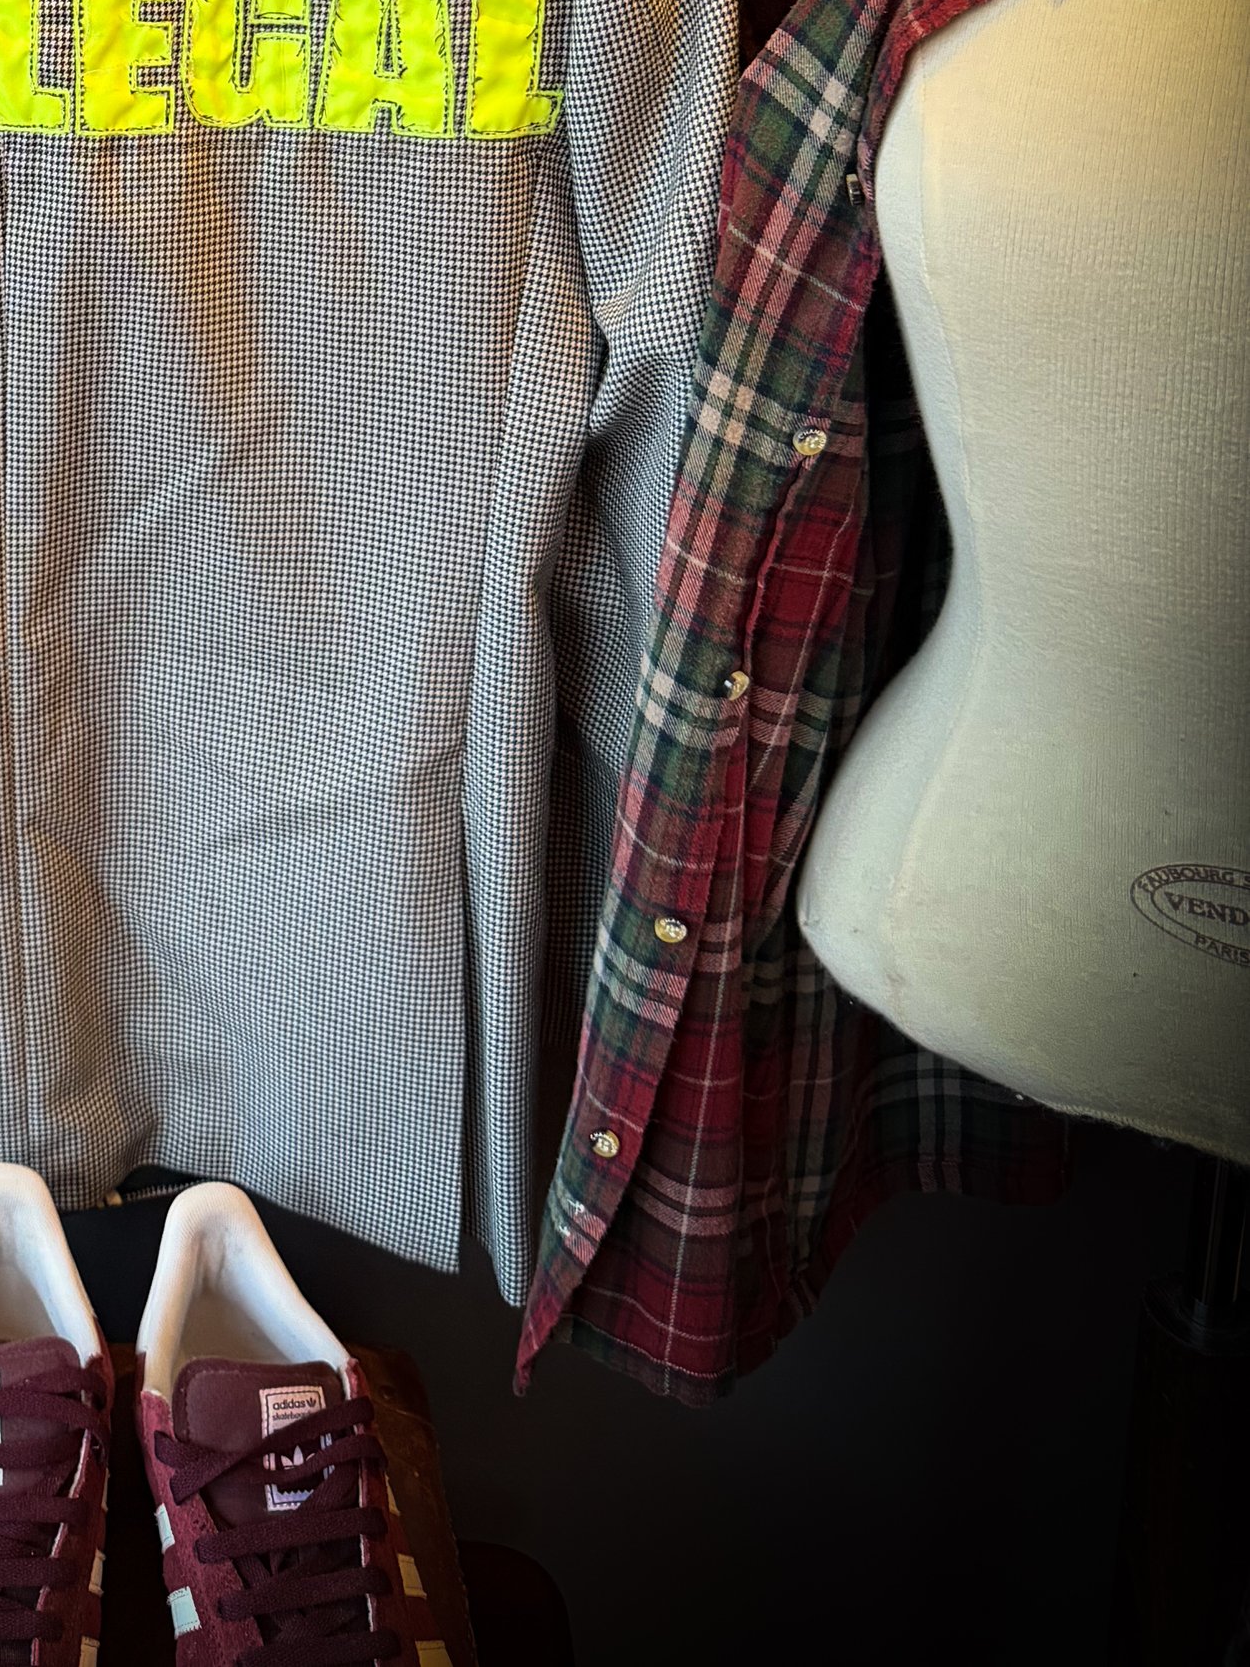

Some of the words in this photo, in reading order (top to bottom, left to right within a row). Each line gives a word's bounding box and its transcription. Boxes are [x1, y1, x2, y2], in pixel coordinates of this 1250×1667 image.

[1138, 867, 1234, 894] FAUBOURG
[1195, 933, 1250, 965] PARIS
[272, 1398, 306, 1410] adidas
